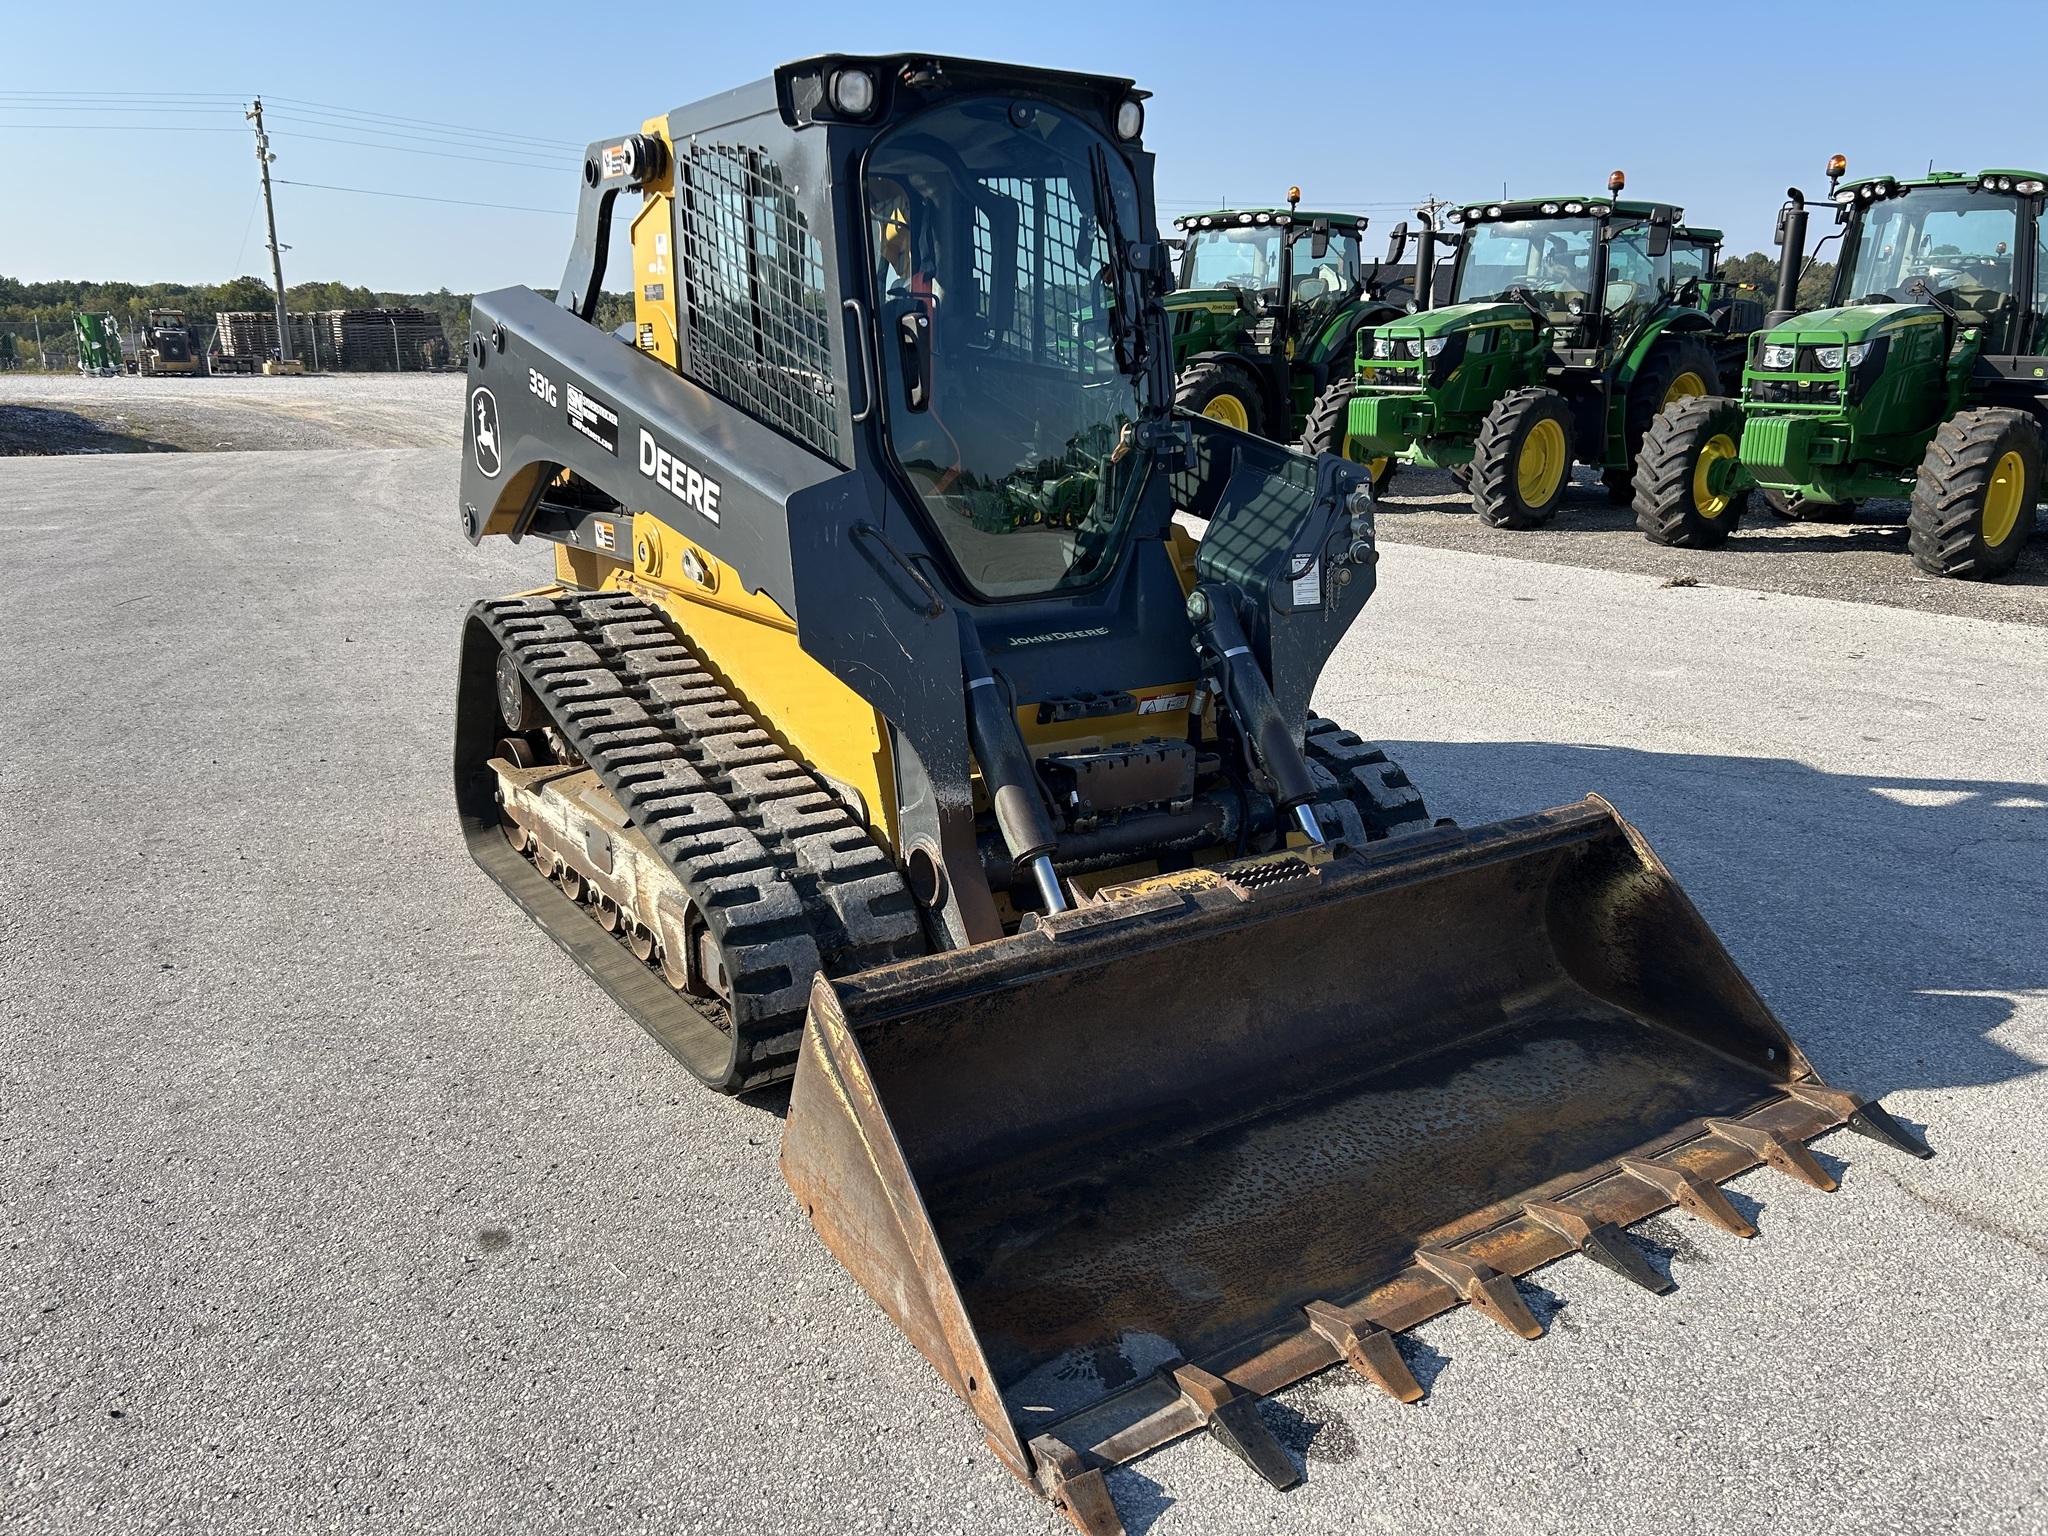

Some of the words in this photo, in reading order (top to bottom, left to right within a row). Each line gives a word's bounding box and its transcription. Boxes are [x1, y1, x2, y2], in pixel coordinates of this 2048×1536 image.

[529, 367, 557, 408] 331G
[640, 427, 720, 525] DEERE
[1010, 634, 1053, 646] JOHN
[1051, 627, 1109, 641] DEERE
